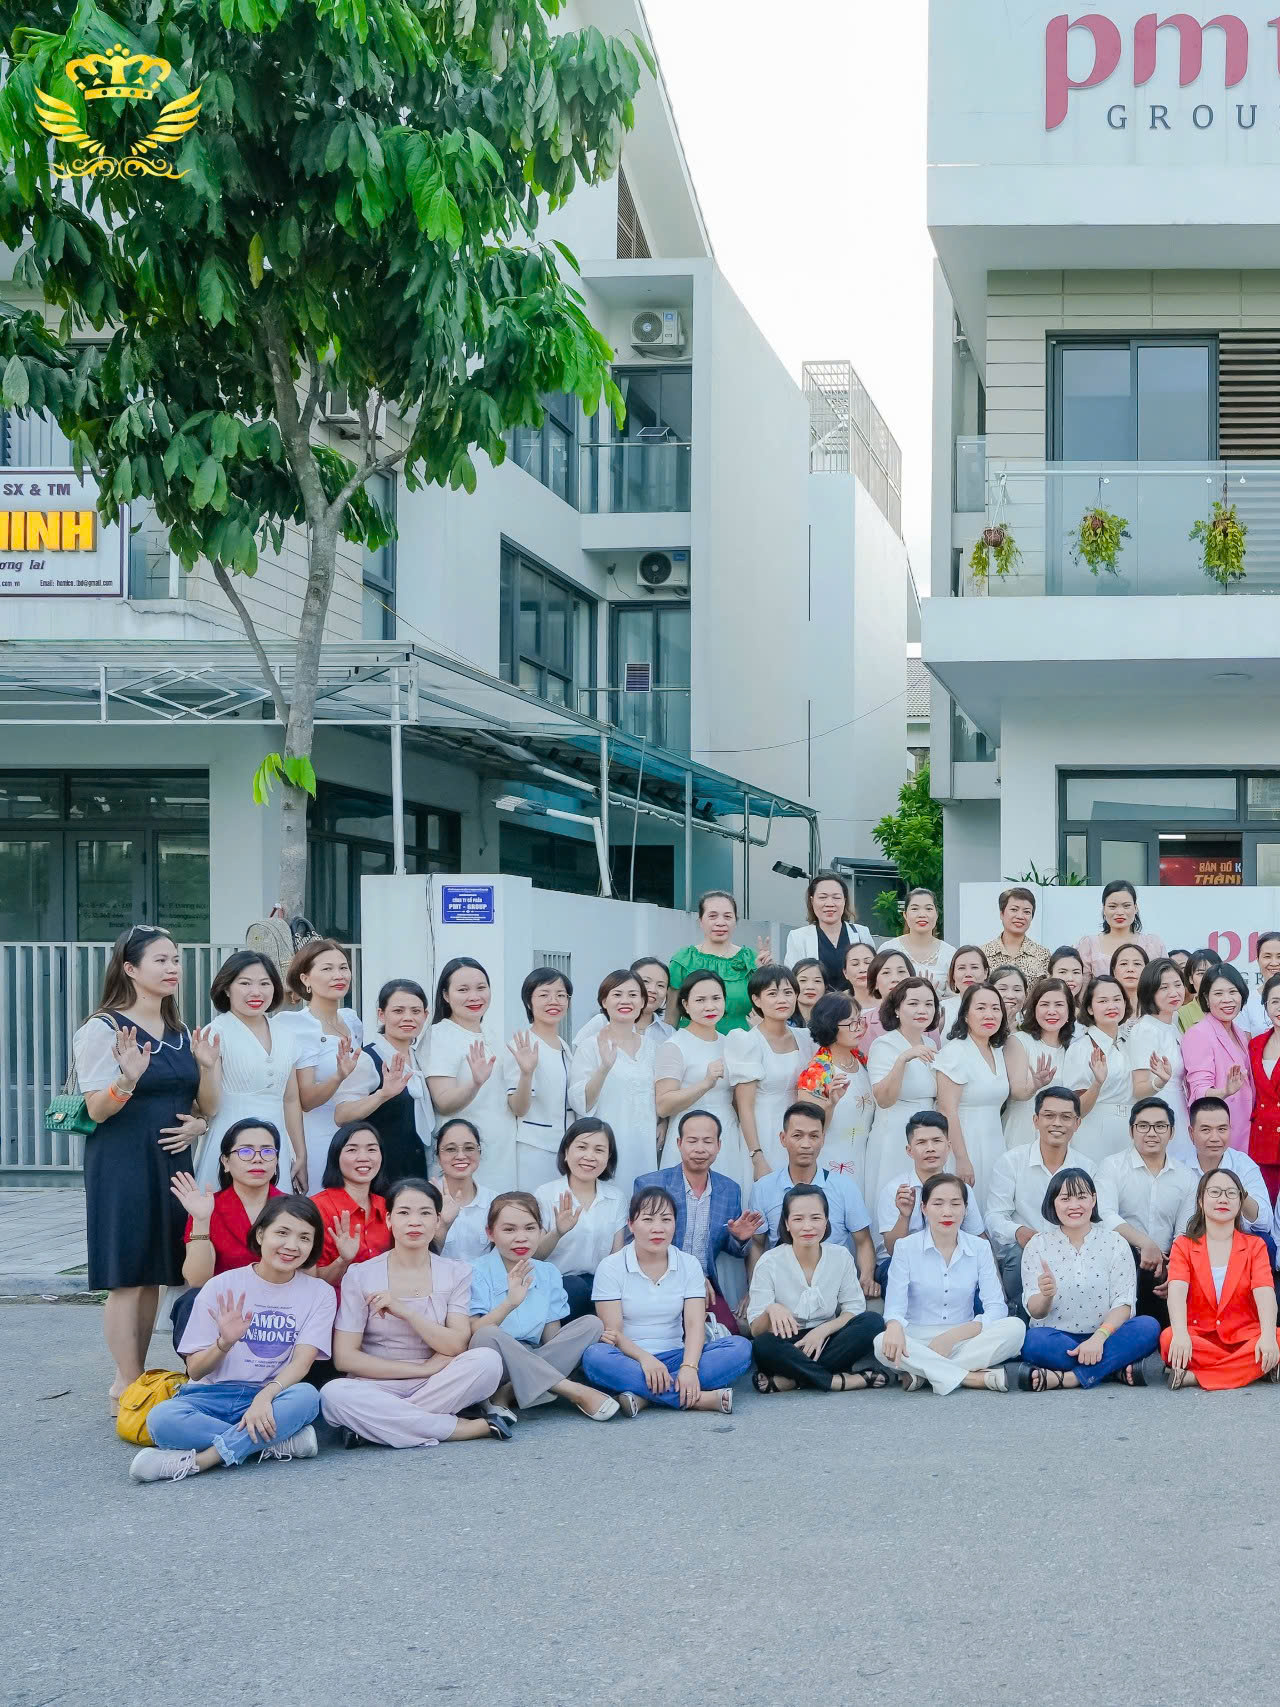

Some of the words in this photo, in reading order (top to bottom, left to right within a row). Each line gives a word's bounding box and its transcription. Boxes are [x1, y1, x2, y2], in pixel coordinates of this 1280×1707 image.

[3, 483, 24, 496] SX
[29, 483, 41, 496] &
[47, 483, 71, 496] TM
